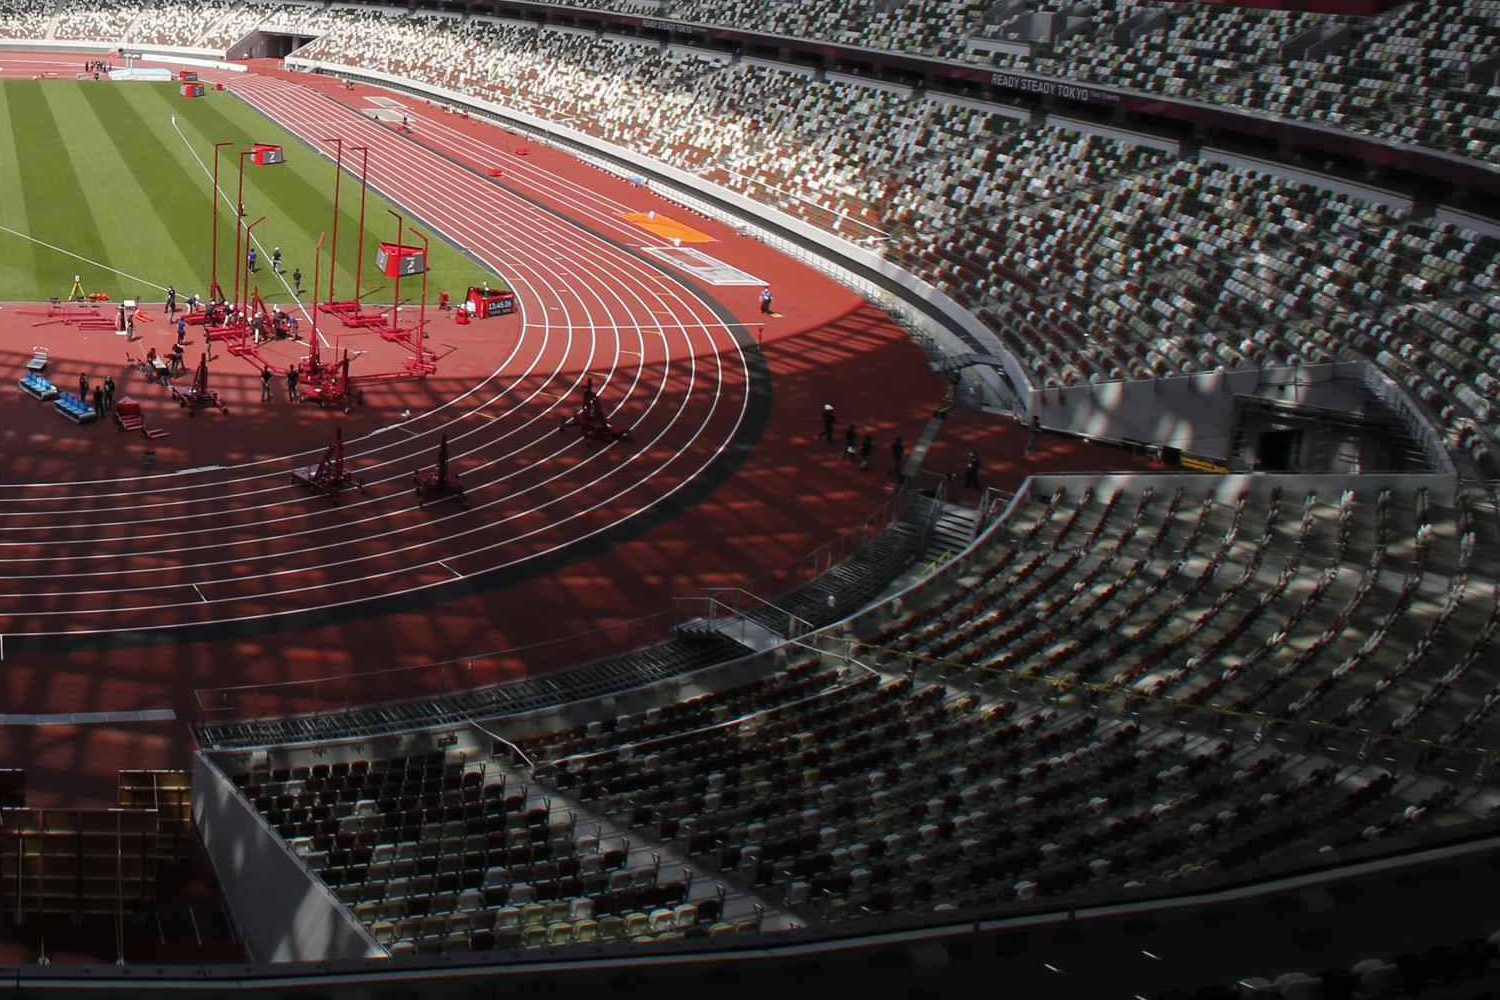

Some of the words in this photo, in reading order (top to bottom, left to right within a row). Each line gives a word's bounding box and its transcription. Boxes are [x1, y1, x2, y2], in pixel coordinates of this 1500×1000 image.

[991, 73, 1019, 89] READY
[1020, 79, 1055, 95] STEADY
[1057, 85, 1088, 101] TOKYO
